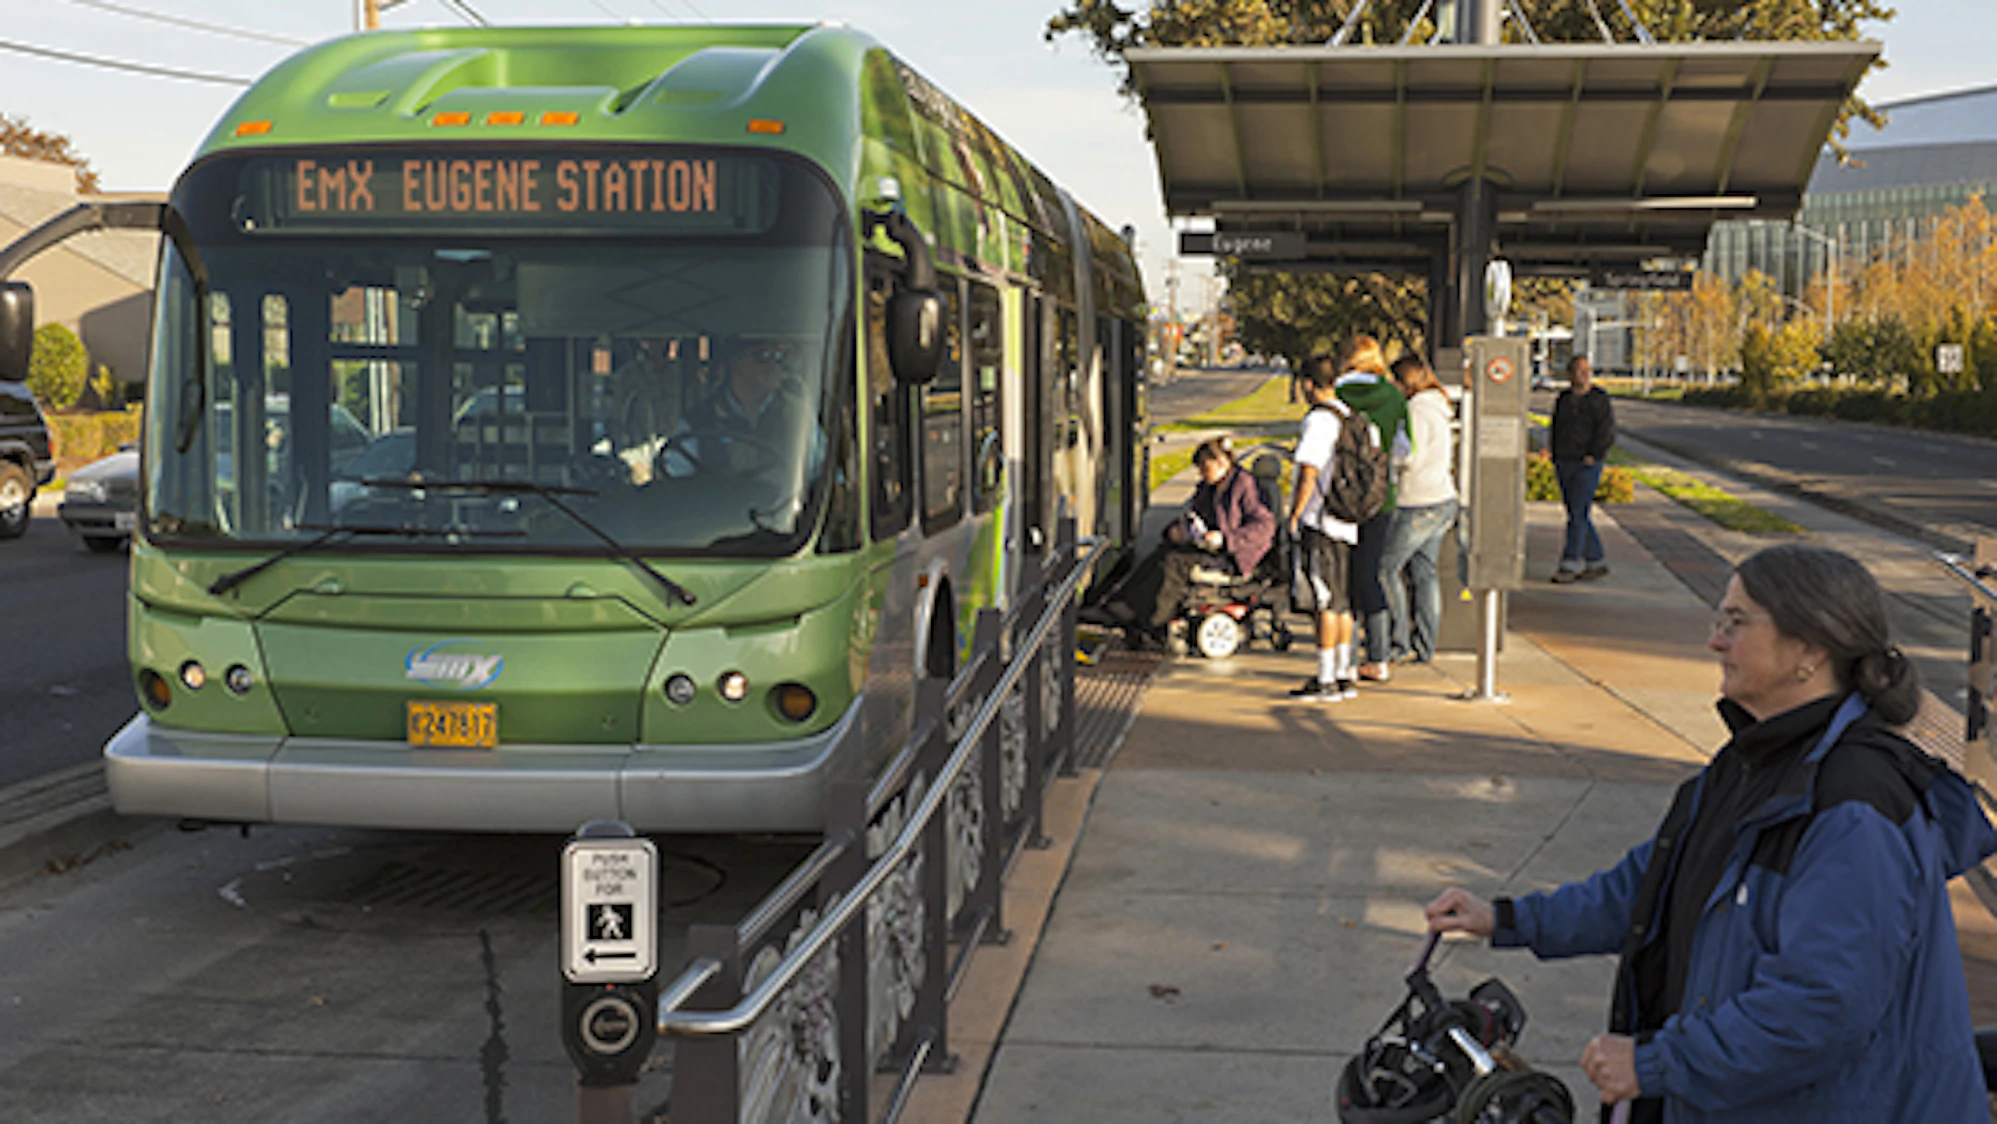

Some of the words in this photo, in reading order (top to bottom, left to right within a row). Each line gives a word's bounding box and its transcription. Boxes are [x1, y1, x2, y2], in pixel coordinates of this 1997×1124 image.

[298, 159, 374, 211] EmX
[403, 159, 541, 211] EUGENE
[556, 159, 717, 211] STATION
[591, 854, 629, 867] PUSH
[583, 869, 638, 881] BUTTON
[595, 884, 623, 896] FOR
